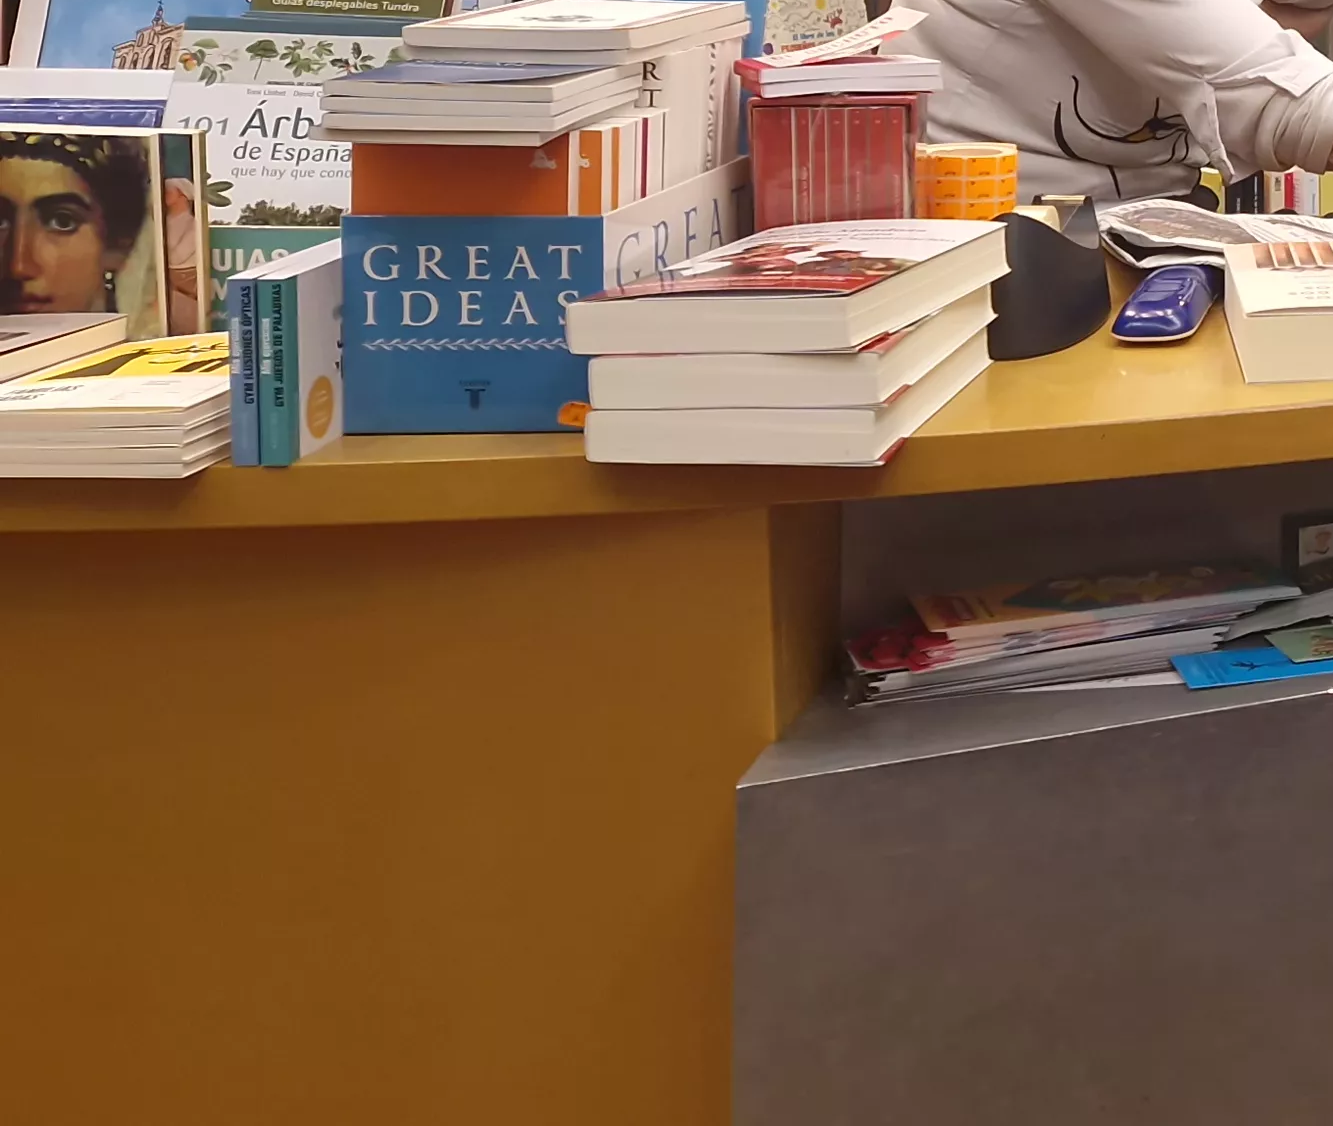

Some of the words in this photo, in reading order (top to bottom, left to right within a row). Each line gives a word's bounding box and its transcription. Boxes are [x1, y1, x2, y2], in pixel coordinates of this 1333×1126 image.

[382, 0, 420, 12] Tundra
[233, 140, 261, 160] de
[270, 142, 353, 167] España
[231, 167, 257, 178] que
[261, 166, 286, 180] hay
[290, 169, 315, 180] que
[362, 243, 582, 281] GREAT
[239, 285, 252, 326] ÓPTICAS
[363, 289, 580, 326] IDEAS
